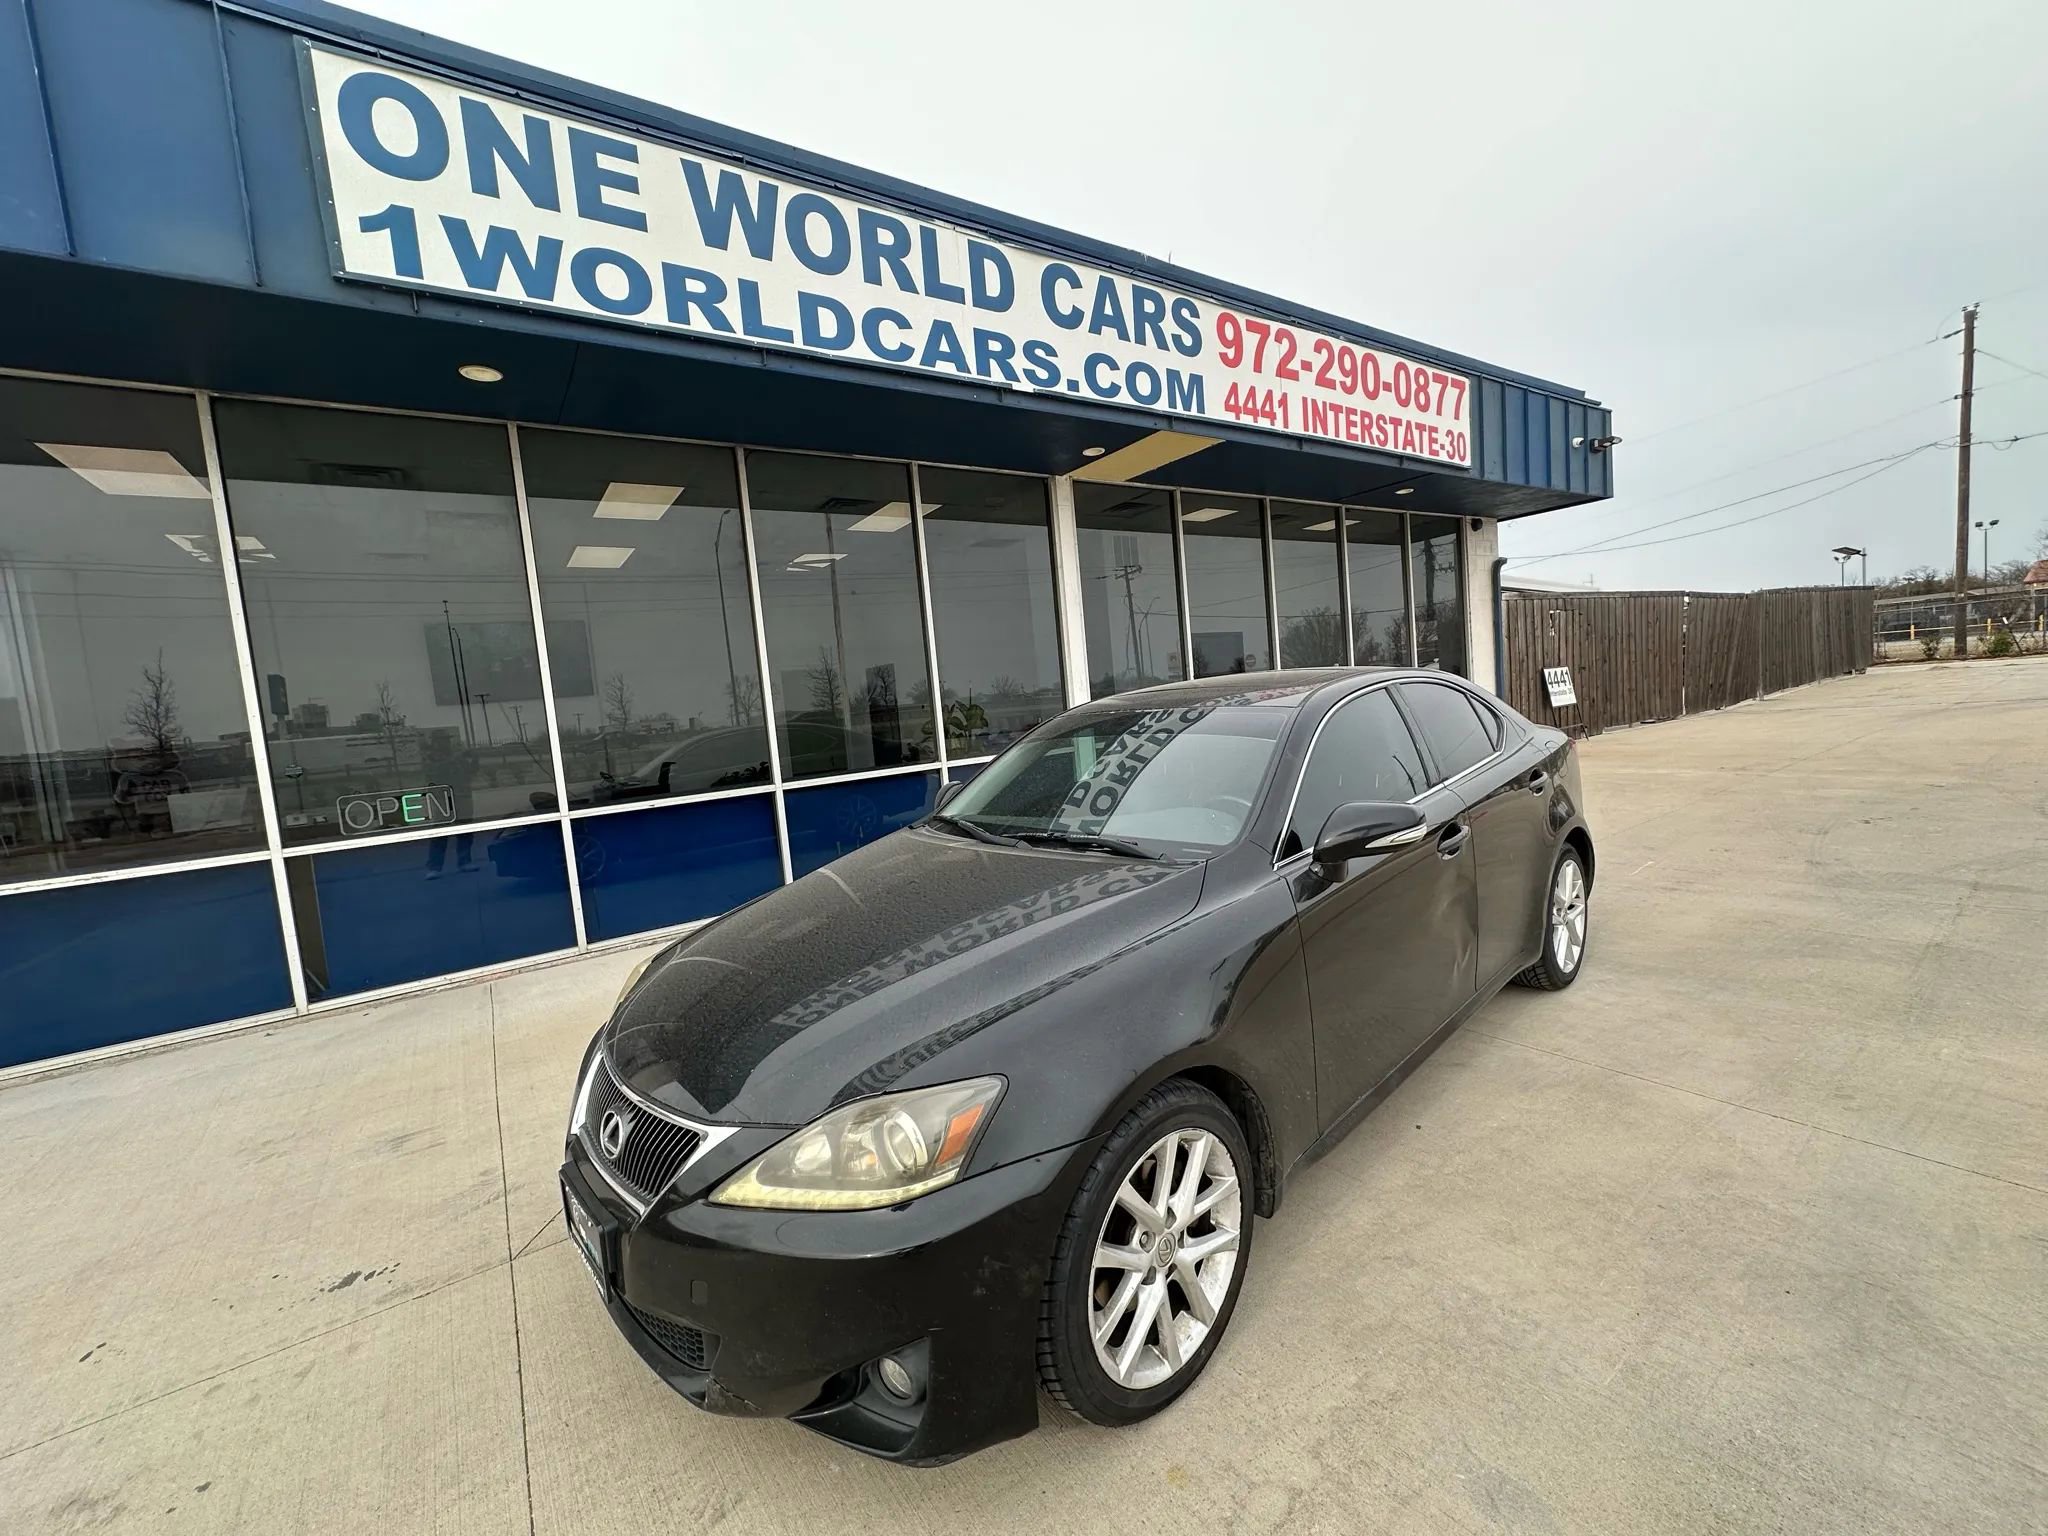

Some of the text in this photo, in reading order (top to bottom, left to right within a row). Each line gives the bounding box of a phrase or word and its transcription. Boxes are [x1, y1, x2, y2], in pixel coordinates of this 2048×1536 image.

[337, 71, 1202, 358] ONE WORLD CARS
[358, 203, 1206, 415] 1WORLDCARS.COM
[1216, 311, 1466, 421] 972-290-0877
[1223, 381, 1467, 463] 4441 INTERSTATE-30
[1547, 669, 1571, 688] 4441
[344, 790, 450, 829] OPEN
